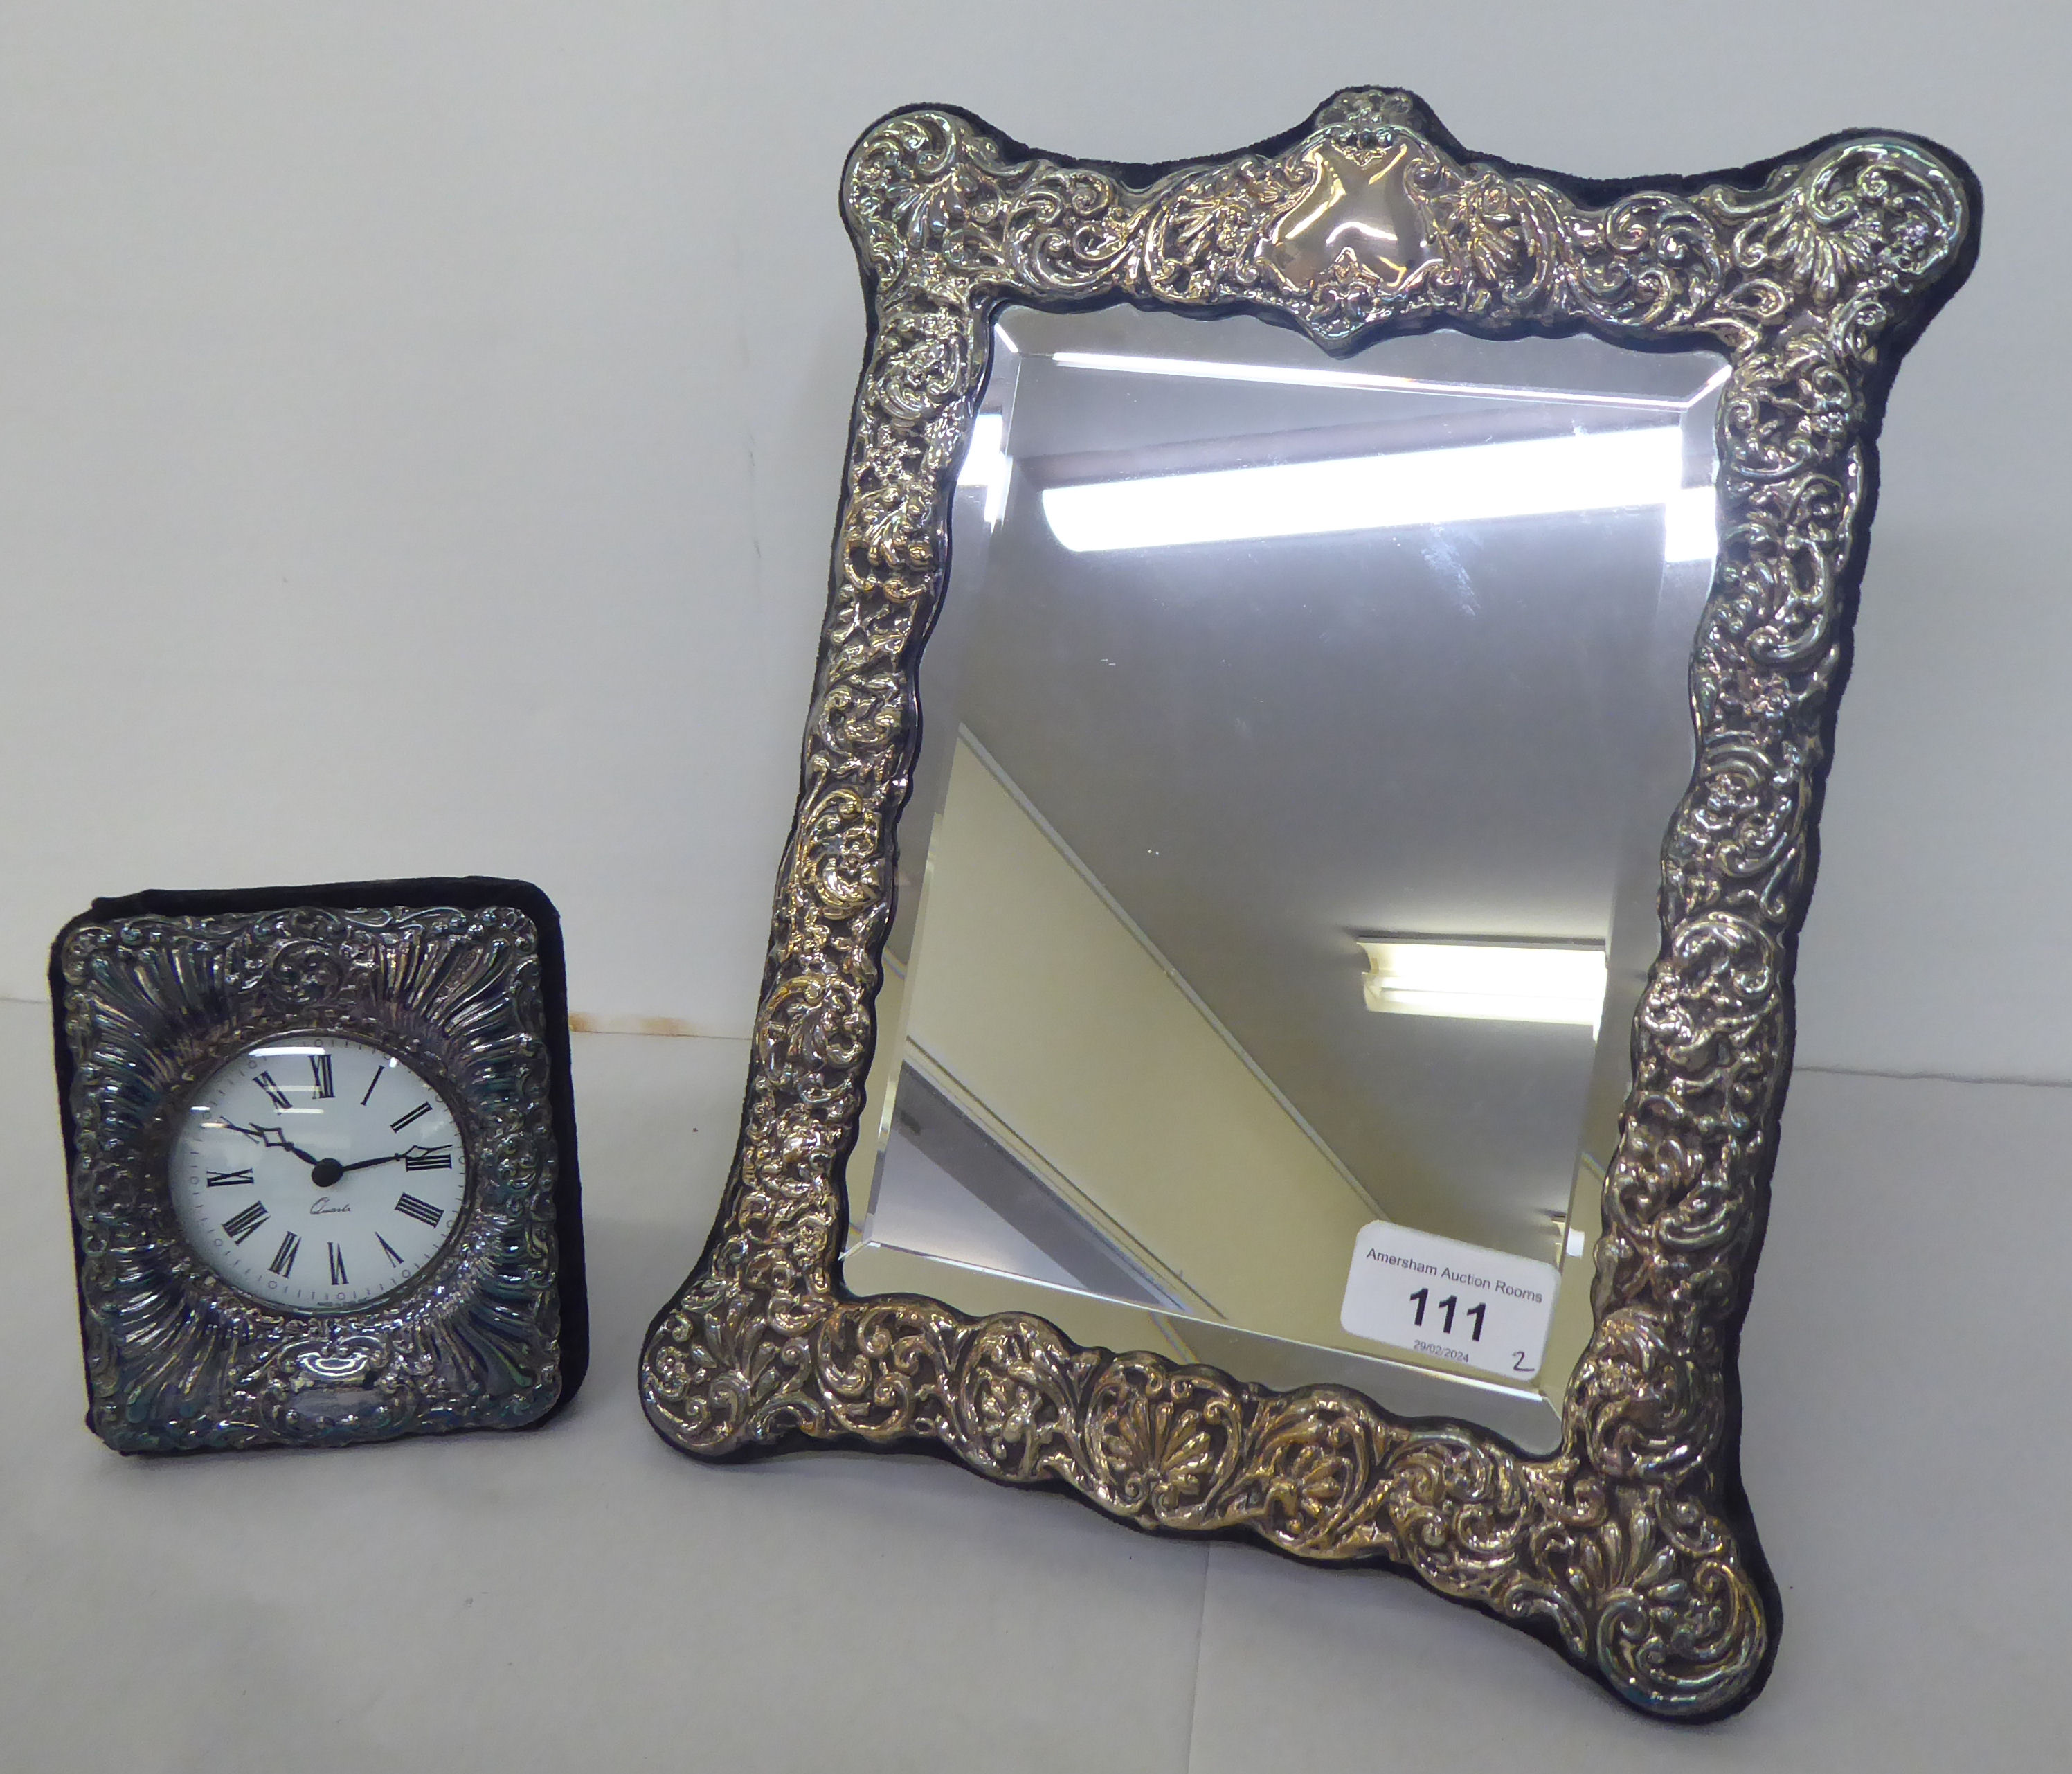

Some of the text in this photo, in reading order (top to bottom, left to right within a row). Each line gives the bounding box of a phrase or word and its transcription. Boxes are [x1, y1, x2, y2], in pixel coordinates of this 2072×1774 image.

[253, 1070, 293, 1116] XI
[307, 1054, 336, 1100] XII
[390, 1101, 433, 1134] II
[206, 1168, 255, 1188] IX
[222, 1200, 272, 1246] VIII
[268, 1230, 303, 1279] VII
[327, 1242, 350, 1285] VI
[375, 1231, 404, 1268] V
[1366, 1248, 1543, 1303] Amersham Auction Rooms
[1409, 1287, 1486, 1341] 111
[1413, 1339, 1469, 1363] 29/02/2024
[1511, 1351, 1535, 1372] 2
